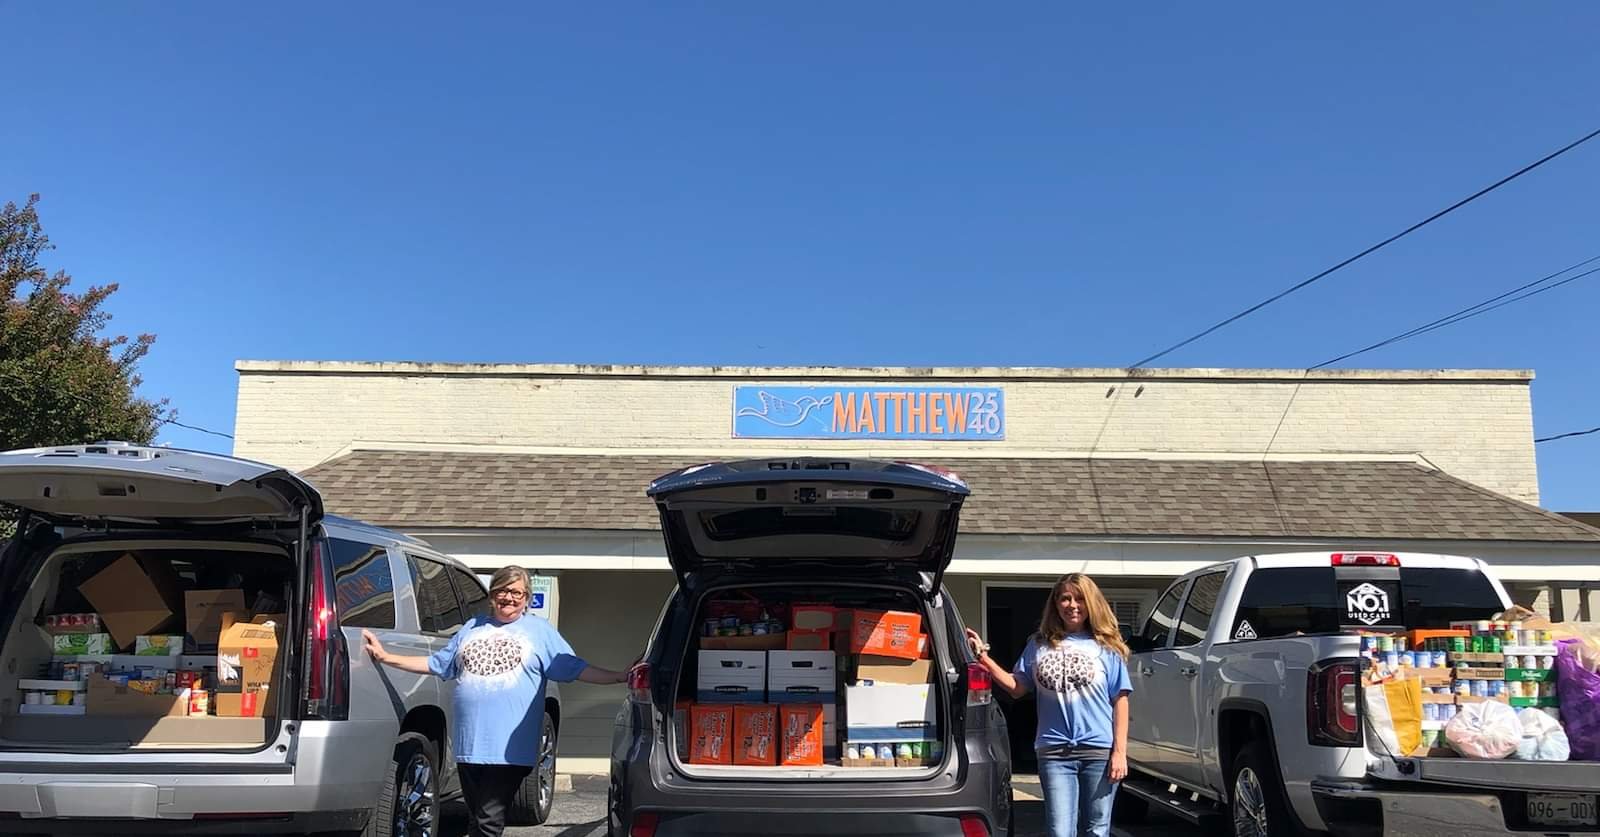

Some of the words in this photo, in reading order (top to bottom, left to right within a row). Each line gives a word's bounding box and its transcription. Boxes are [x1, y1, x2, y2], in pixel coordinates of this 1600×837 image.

[832, 391, 970, 434] MATTHEW
[971, 391, 999, 414] 25
[967, 411, 1000, 435] 40
[1346, 593, 1390, 612] NO.1
